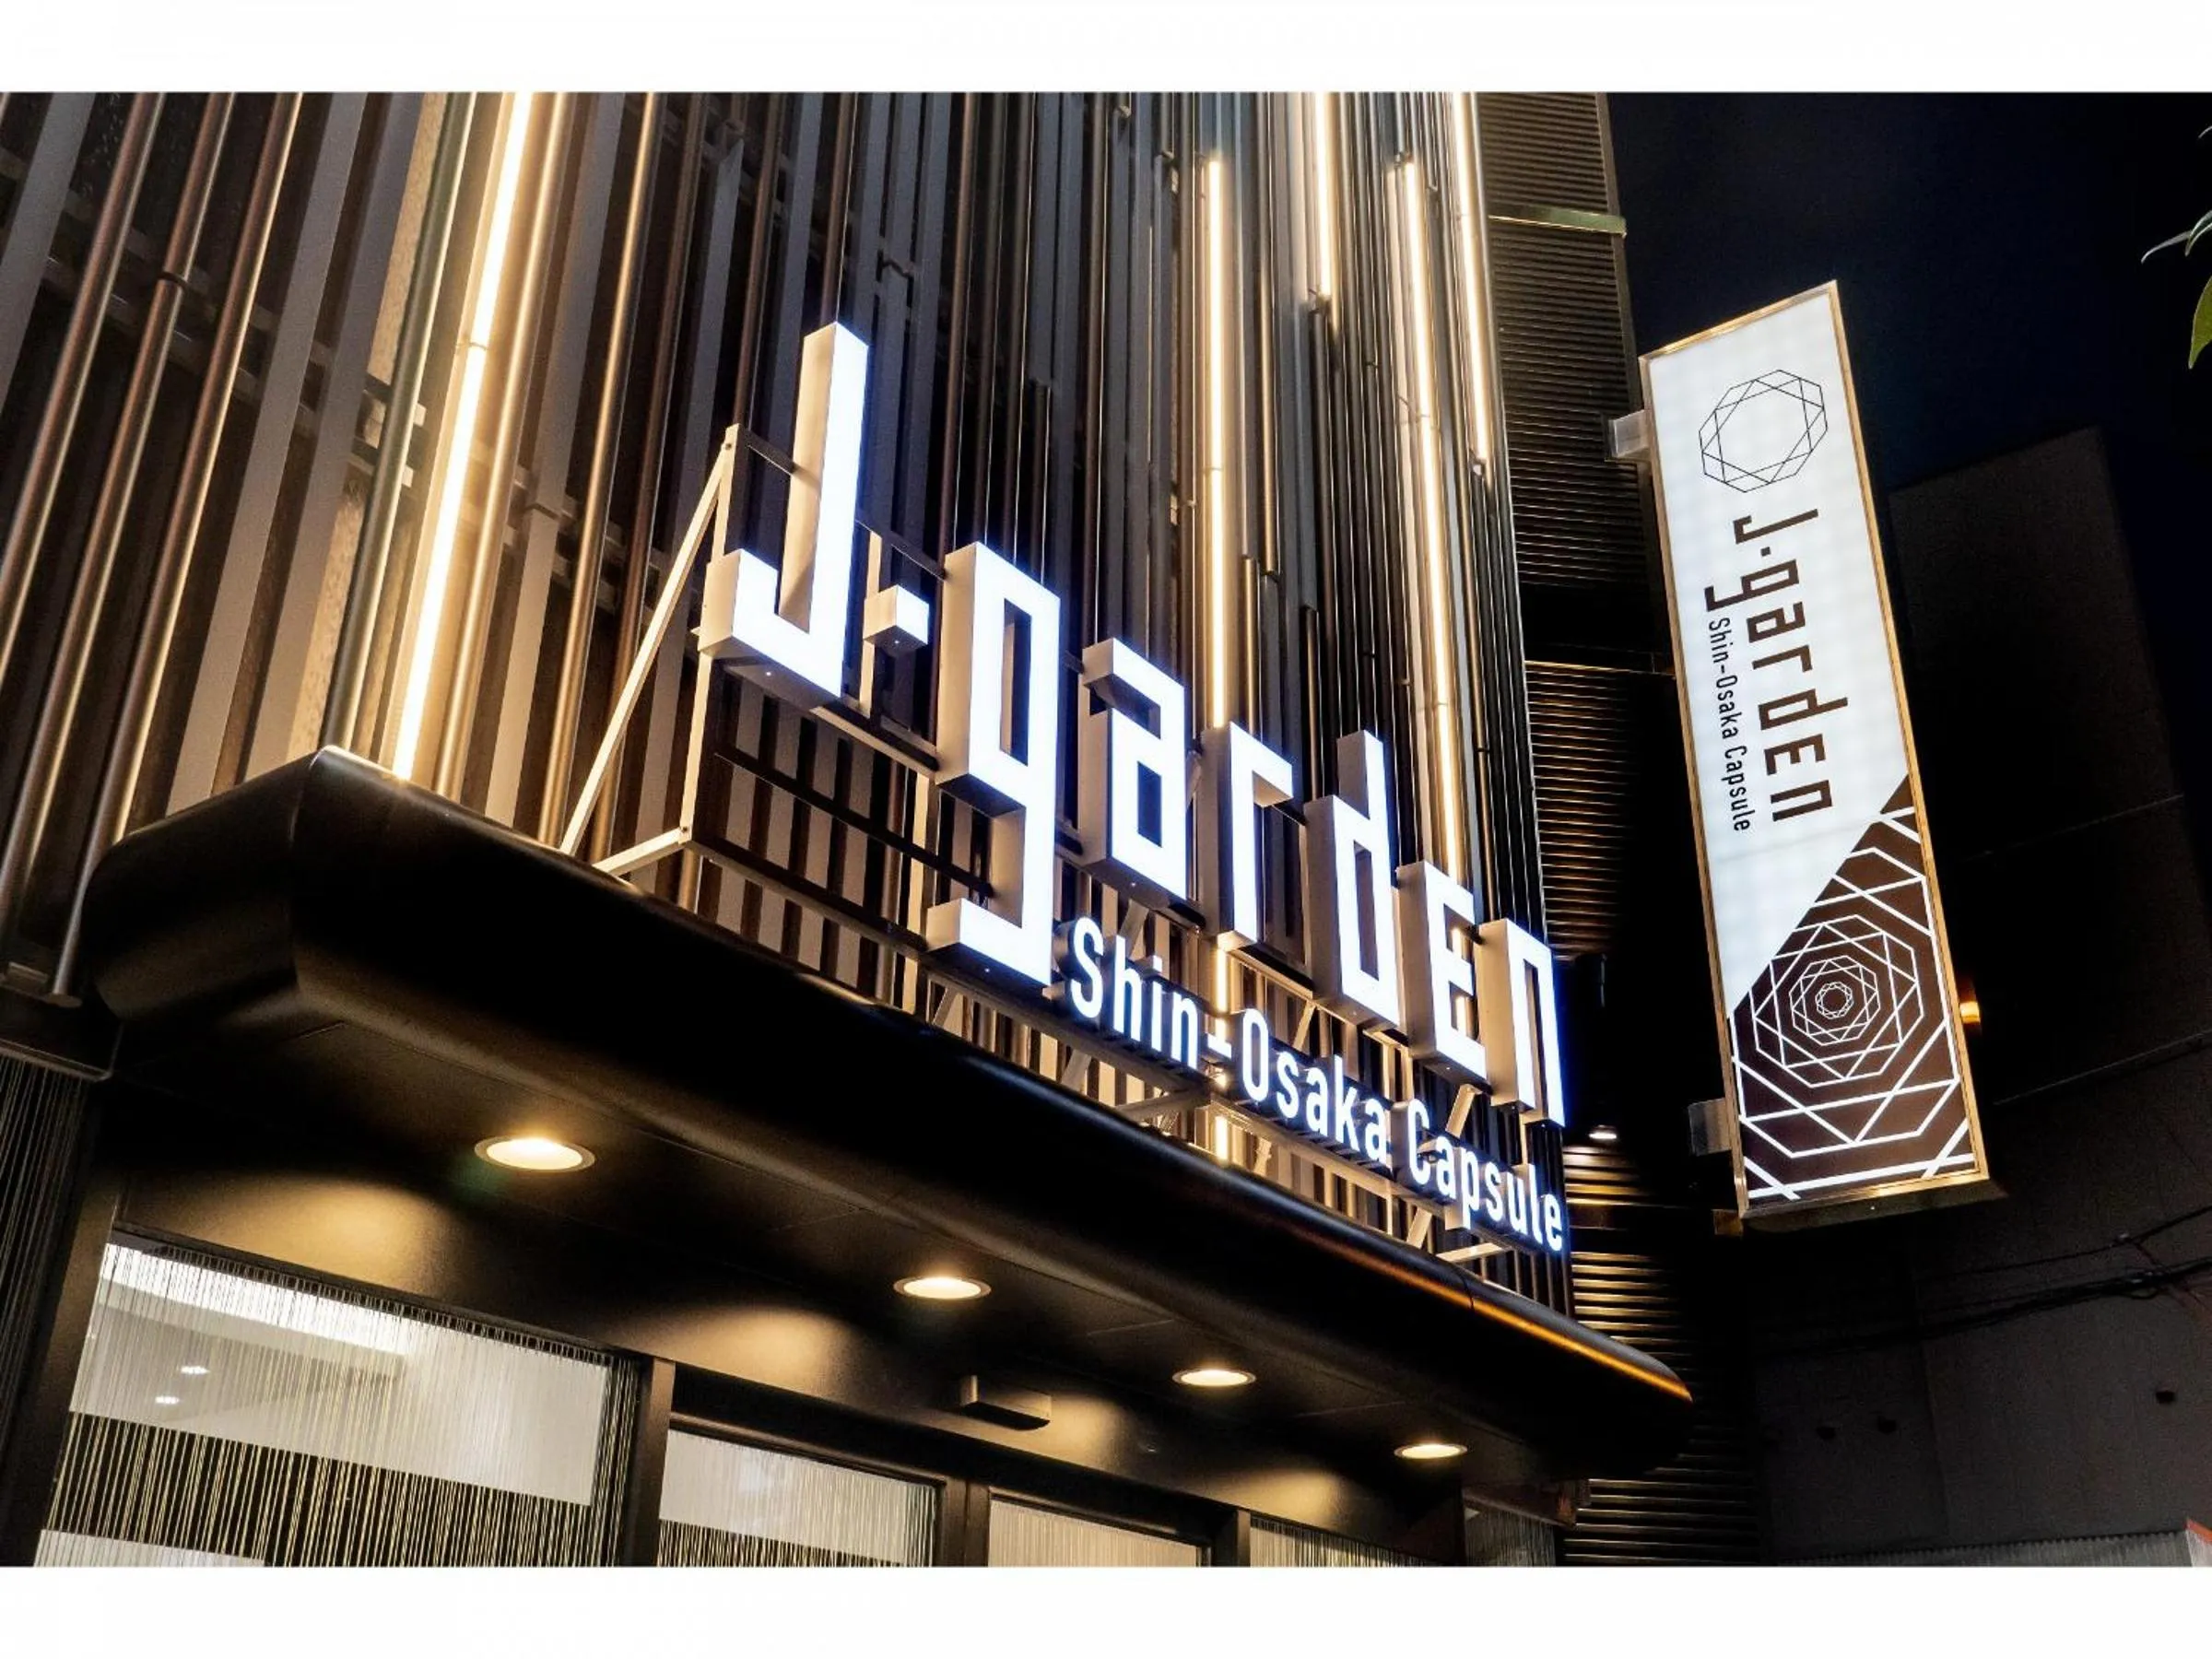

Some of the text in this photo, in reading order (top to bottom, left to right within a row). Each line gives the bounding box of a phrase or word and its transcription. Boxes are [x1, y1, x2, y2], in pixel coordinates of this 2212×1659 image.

[1708, 617, 1753, 831] Shin-Osaka Capsule
[1070, 915, 1564, 1253] Shin-Osaka Capsule
